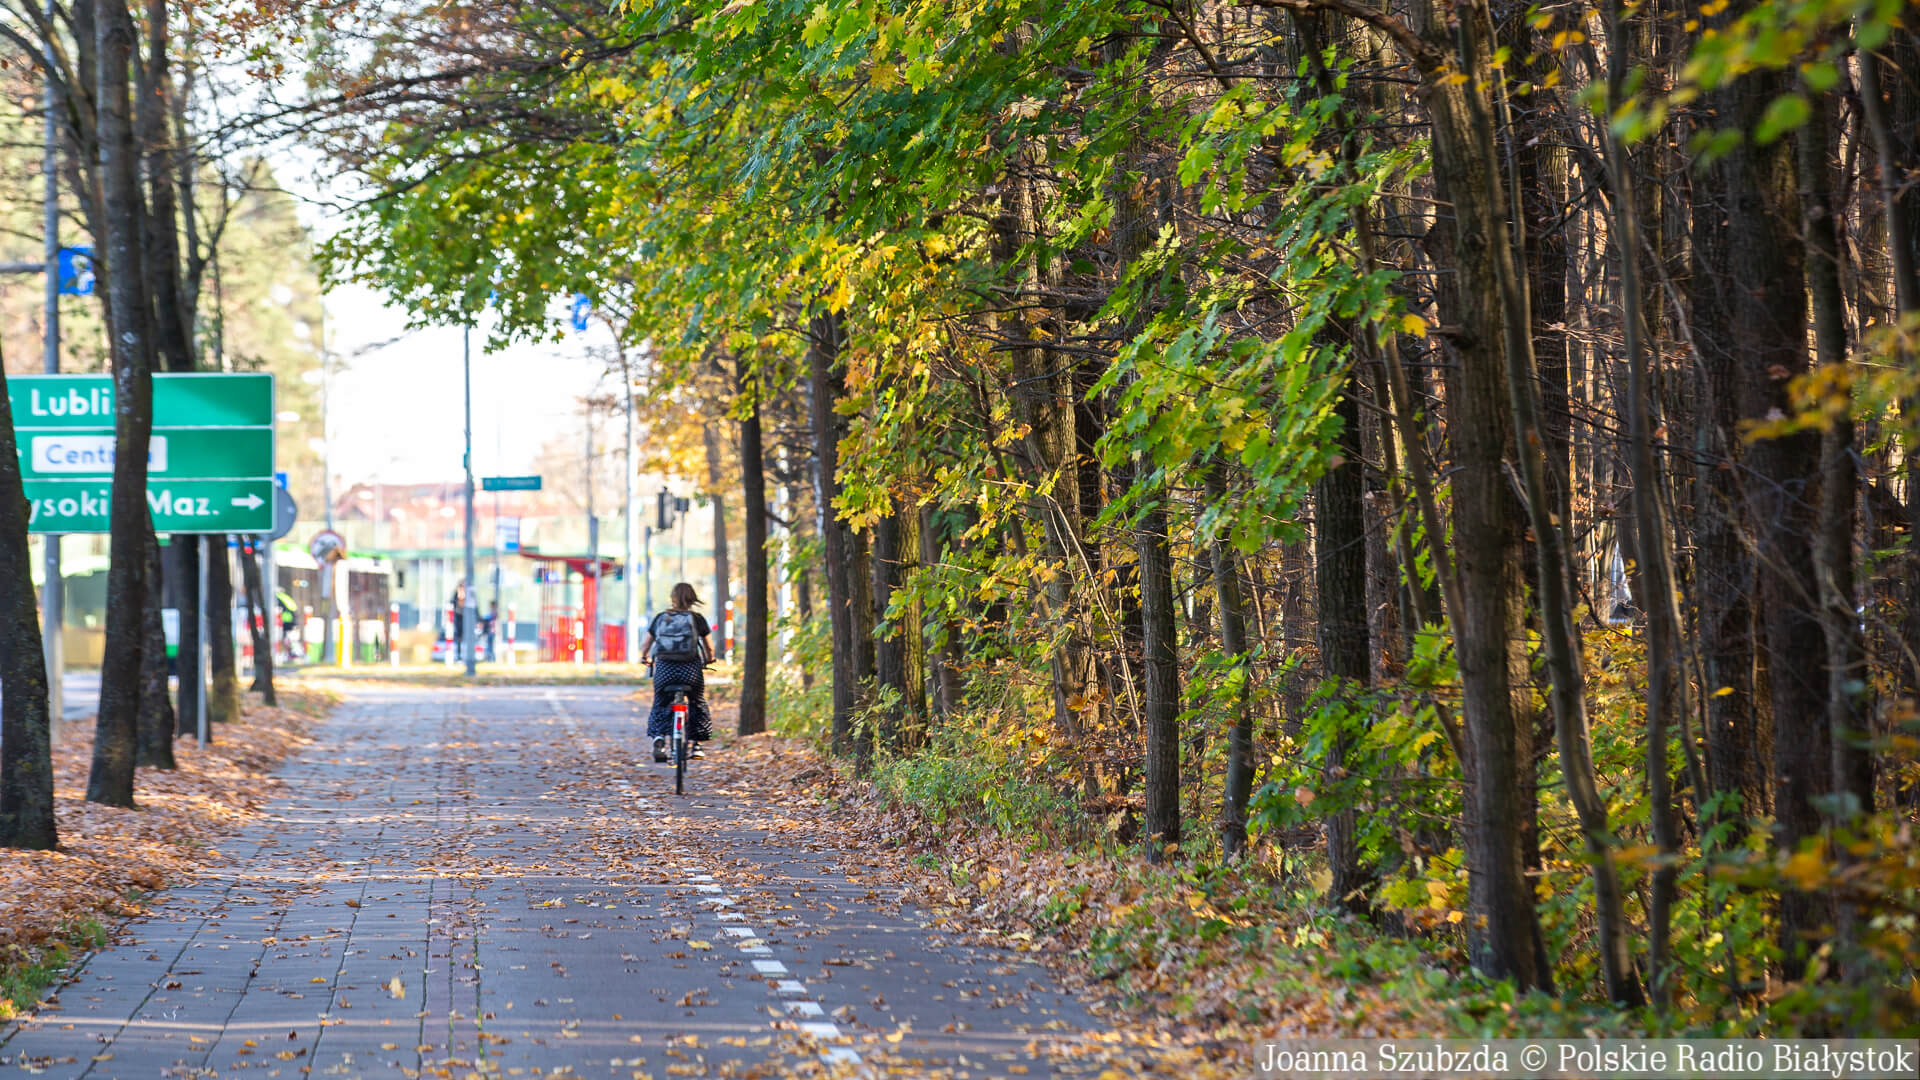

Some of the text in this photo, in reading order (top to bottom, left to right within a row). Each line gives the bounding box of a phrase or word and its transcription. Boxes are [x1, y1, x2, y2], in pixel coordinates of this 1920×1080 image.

[31, 388, 116, 416] Lubli
[29, 489, 220, 524] ysoki Maz.
